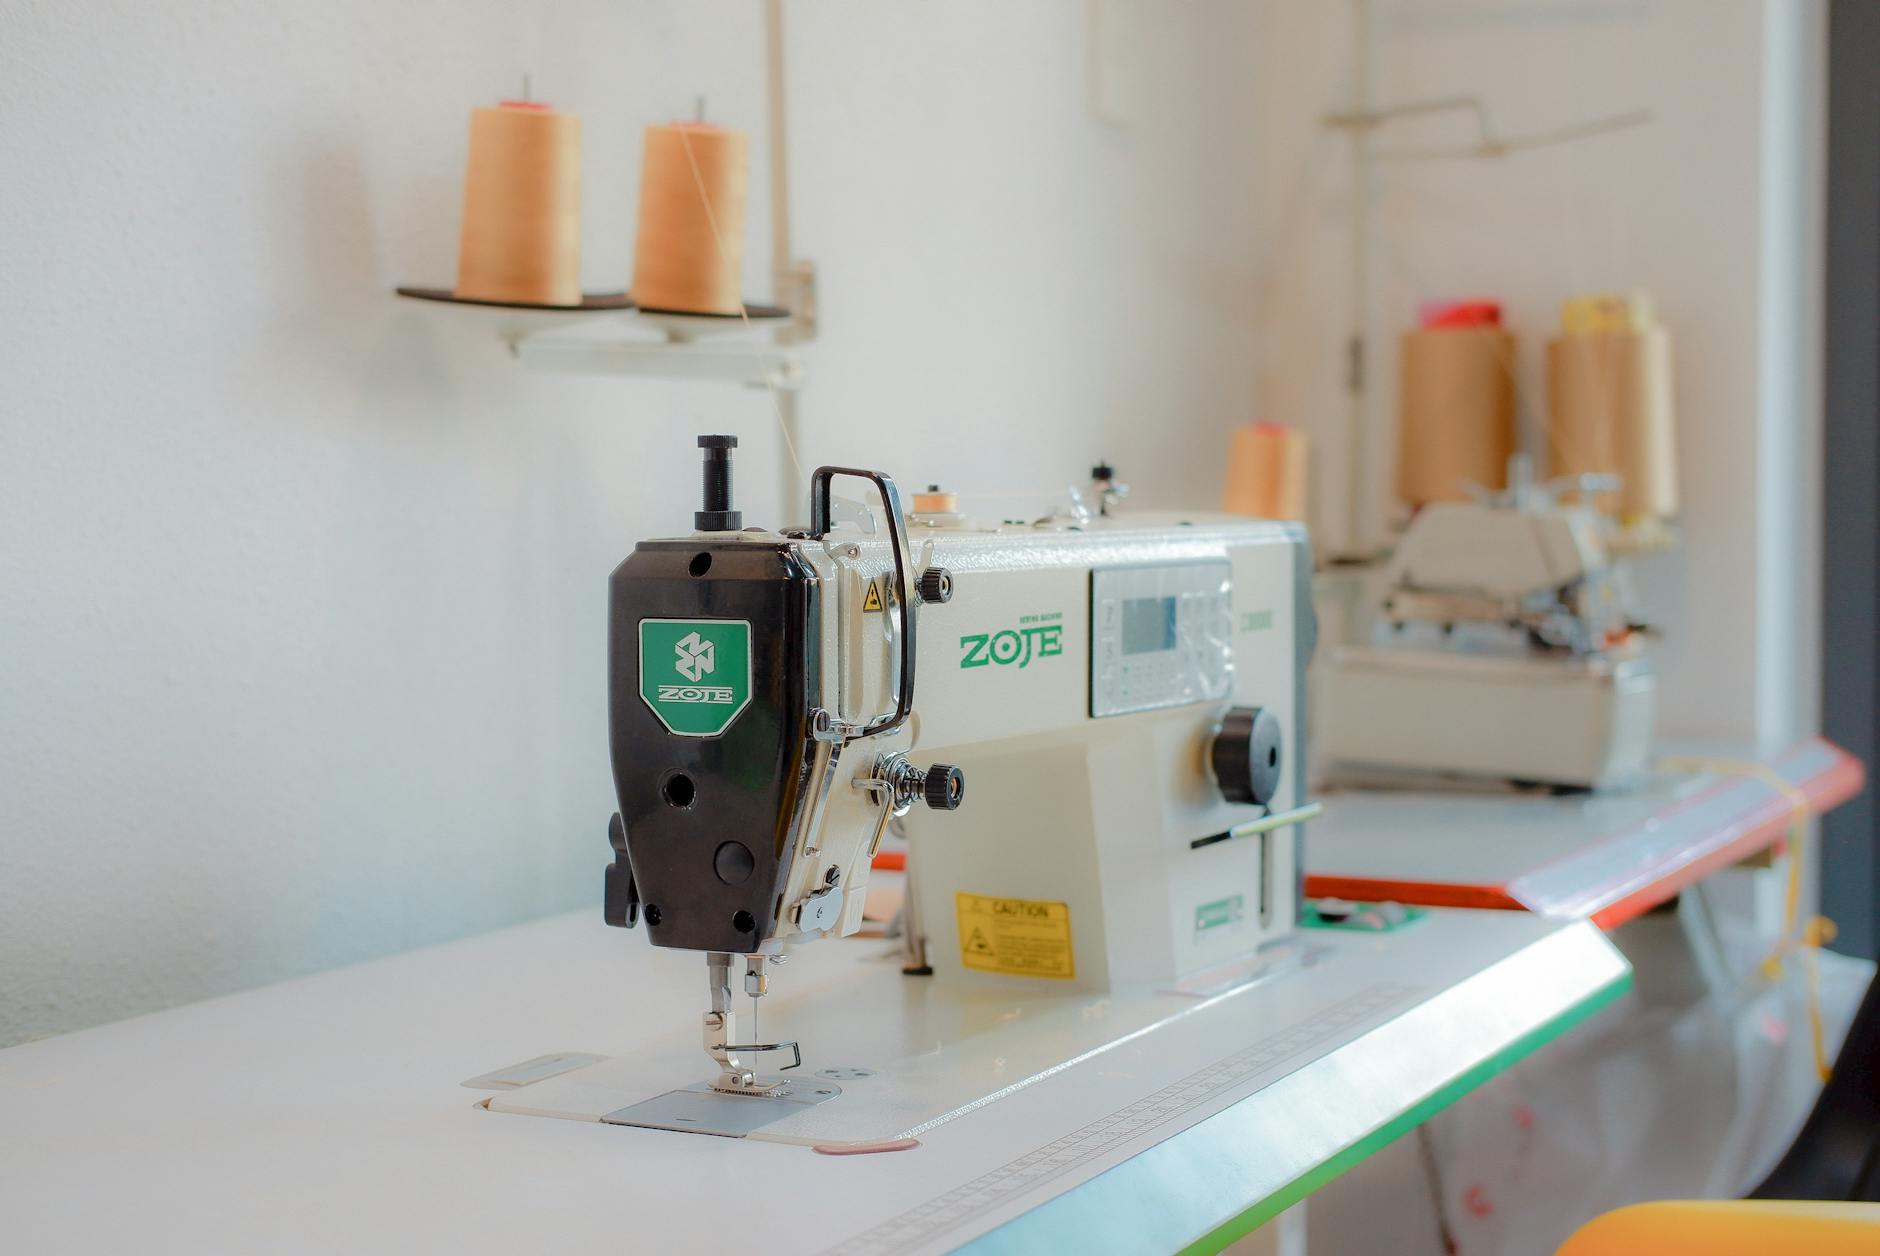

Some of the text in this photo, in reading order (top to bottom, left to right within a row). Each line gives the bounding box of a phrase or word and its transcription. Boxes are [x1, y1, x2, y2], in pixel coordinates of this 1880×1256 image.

[960, 625, 1062, 669] ZOJE
[658, 687, 733, 703] ZOJE
[993, 900, 1049, 918] CAUTION
